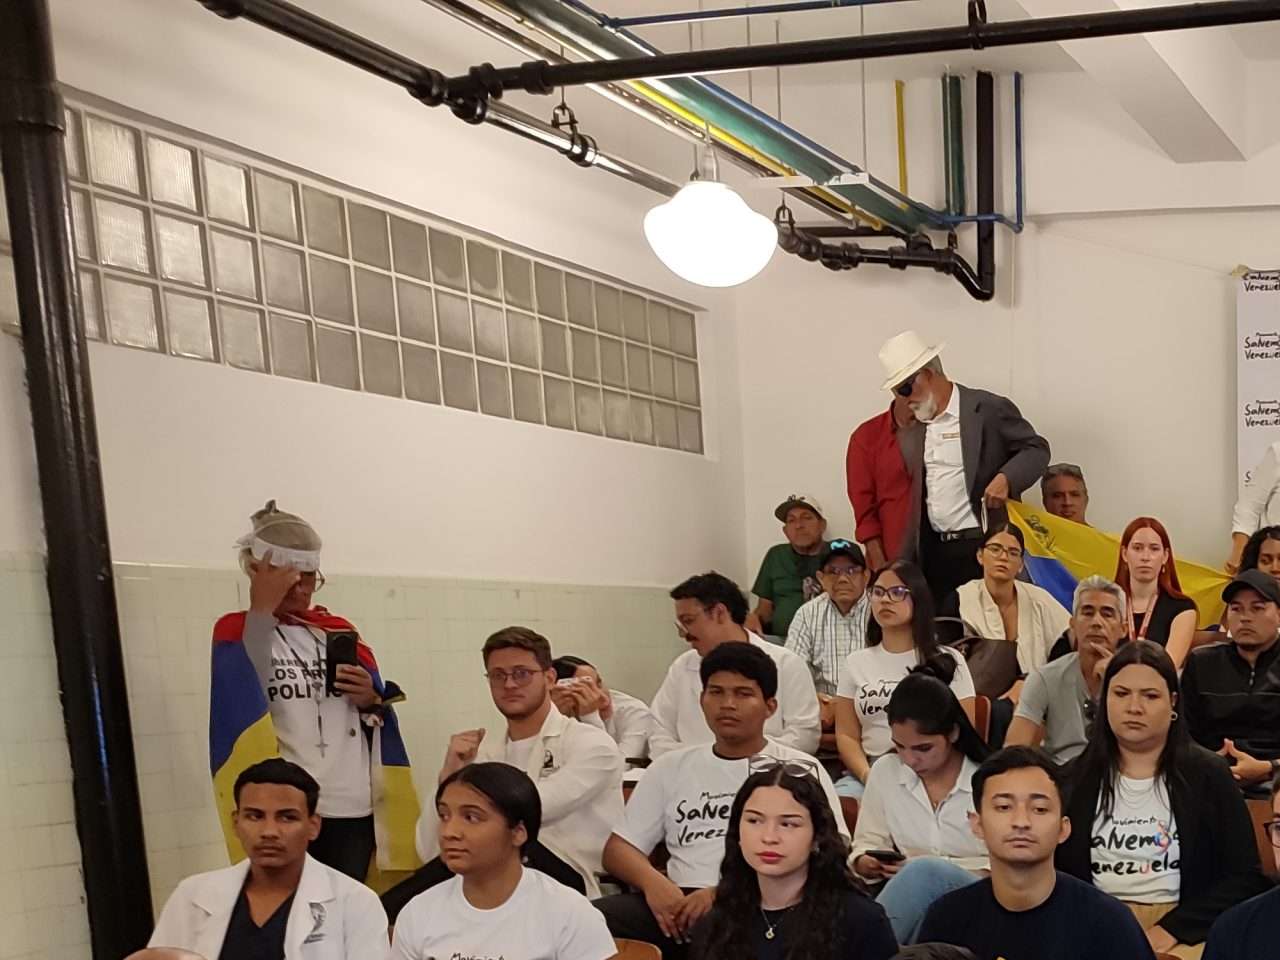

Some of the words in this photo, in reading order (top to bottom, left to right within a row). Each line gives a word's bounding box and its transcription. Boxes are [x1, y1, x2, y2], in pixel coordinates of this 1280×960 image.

[676, 799, 731, 824] Salve
[677, 825, 727, 847] Venez
[1091, 853, 1181, 876] enezuela
